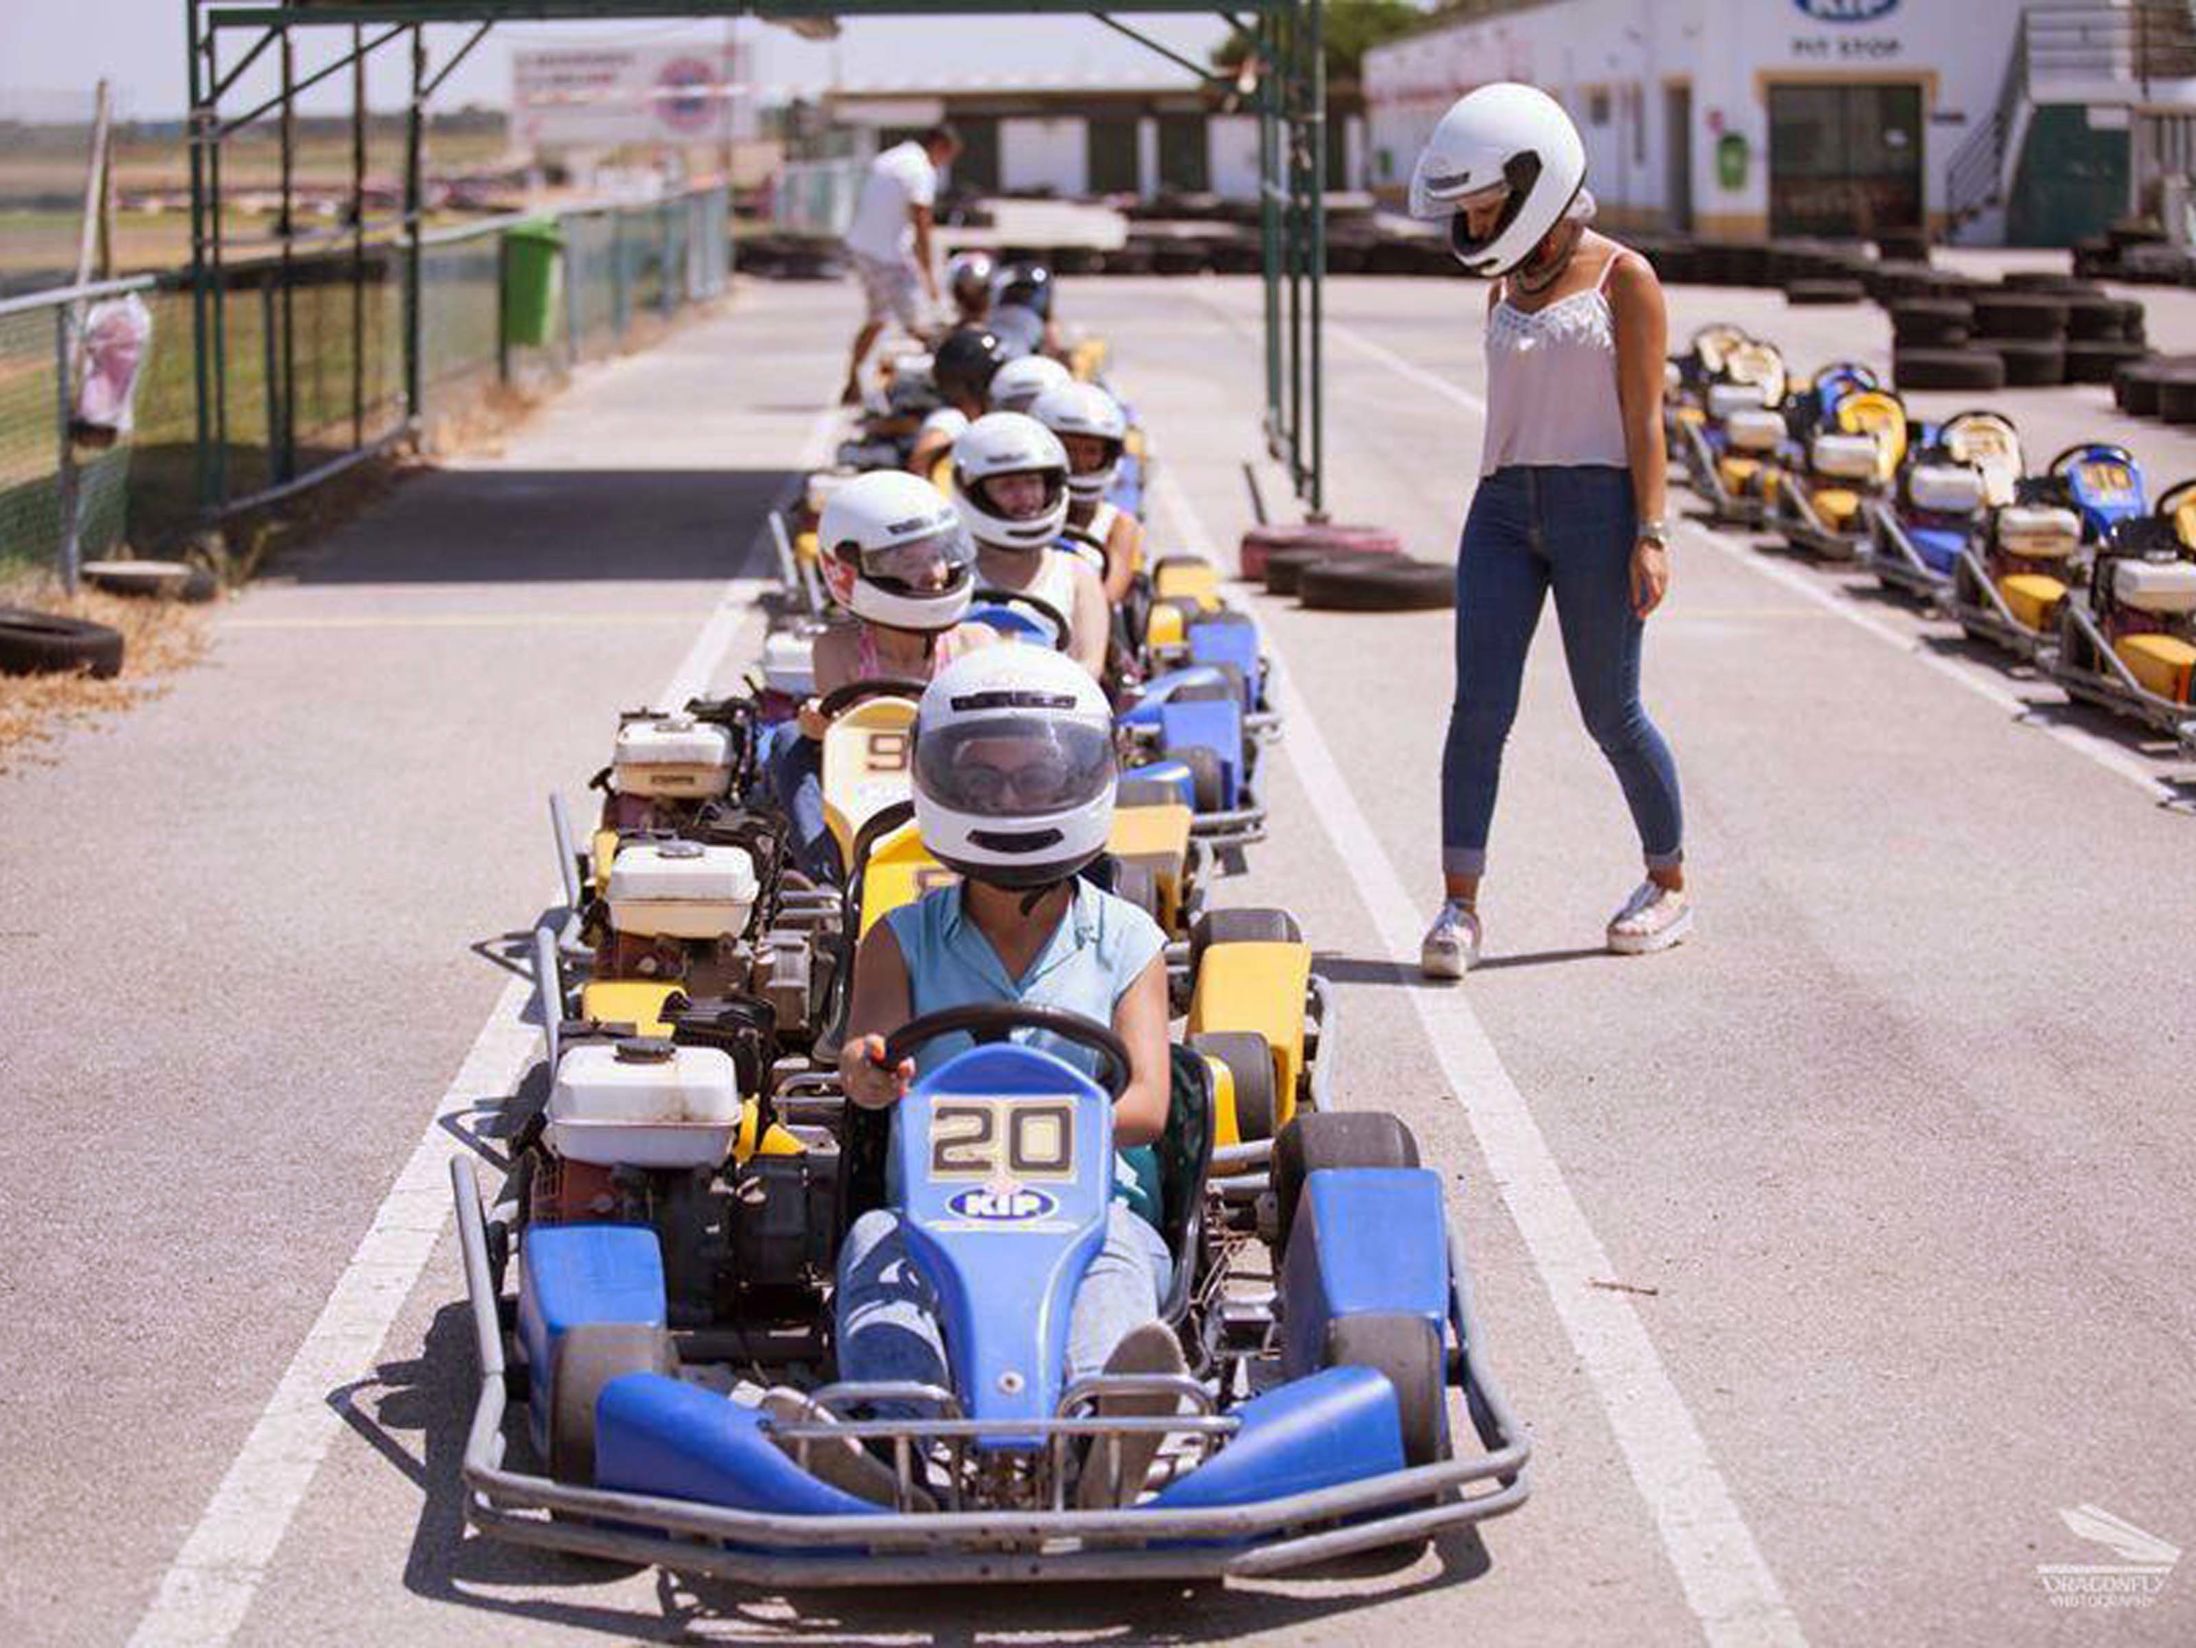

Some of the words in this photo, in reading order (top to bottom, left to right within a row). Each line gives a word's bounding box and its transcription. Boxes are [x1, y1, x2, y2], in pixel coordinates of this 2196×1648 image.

[867, 733, 908, 771] 9
[933, 1106, 1072, 1171] 20
[963, 1192, 1043, 1217] KIP
